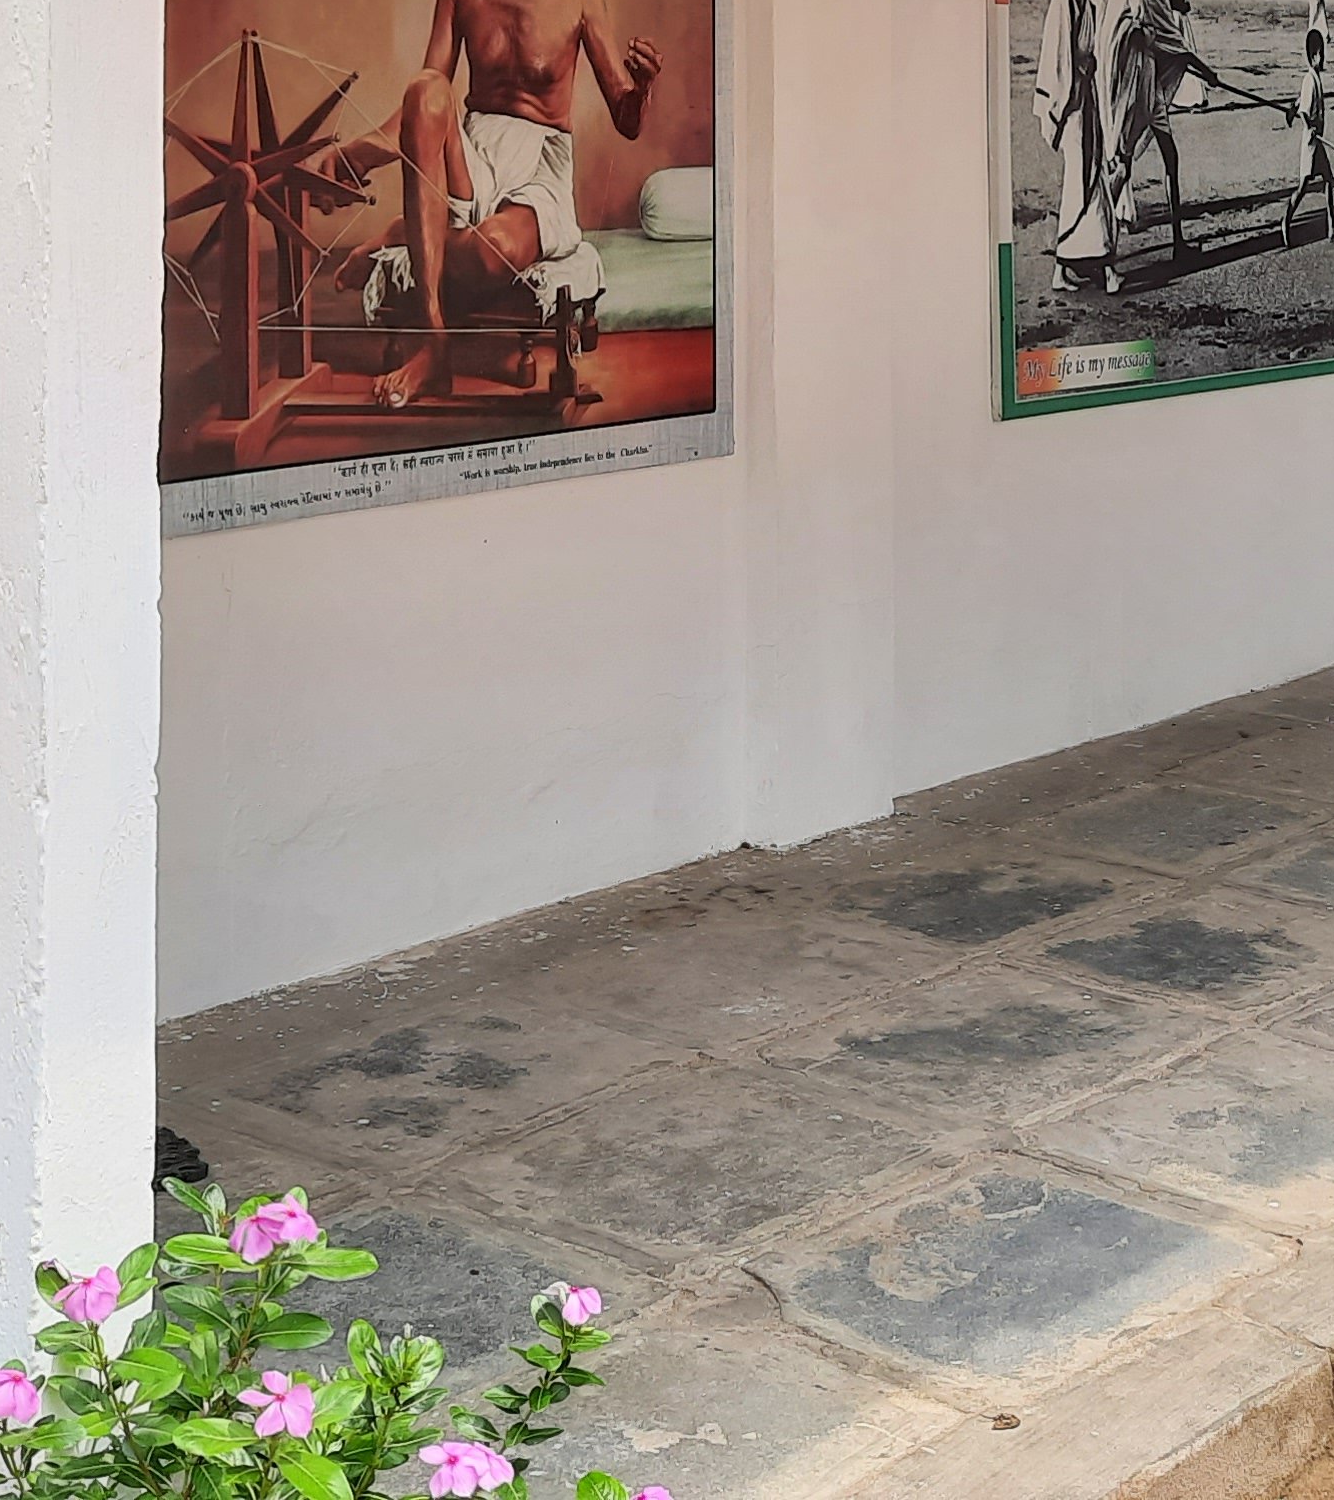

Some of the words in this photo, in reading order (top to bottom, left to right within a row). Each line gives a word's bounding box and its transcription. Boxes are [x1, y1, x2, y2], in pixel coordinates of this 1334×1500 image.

[1024, 358, 1044, 387] My
[1049, 353, 1073, 383] Life
[1076, 354, 1086, 374] is
[1089, 357, 1105, 379] my
[1108, 350, 1151, 375] message
